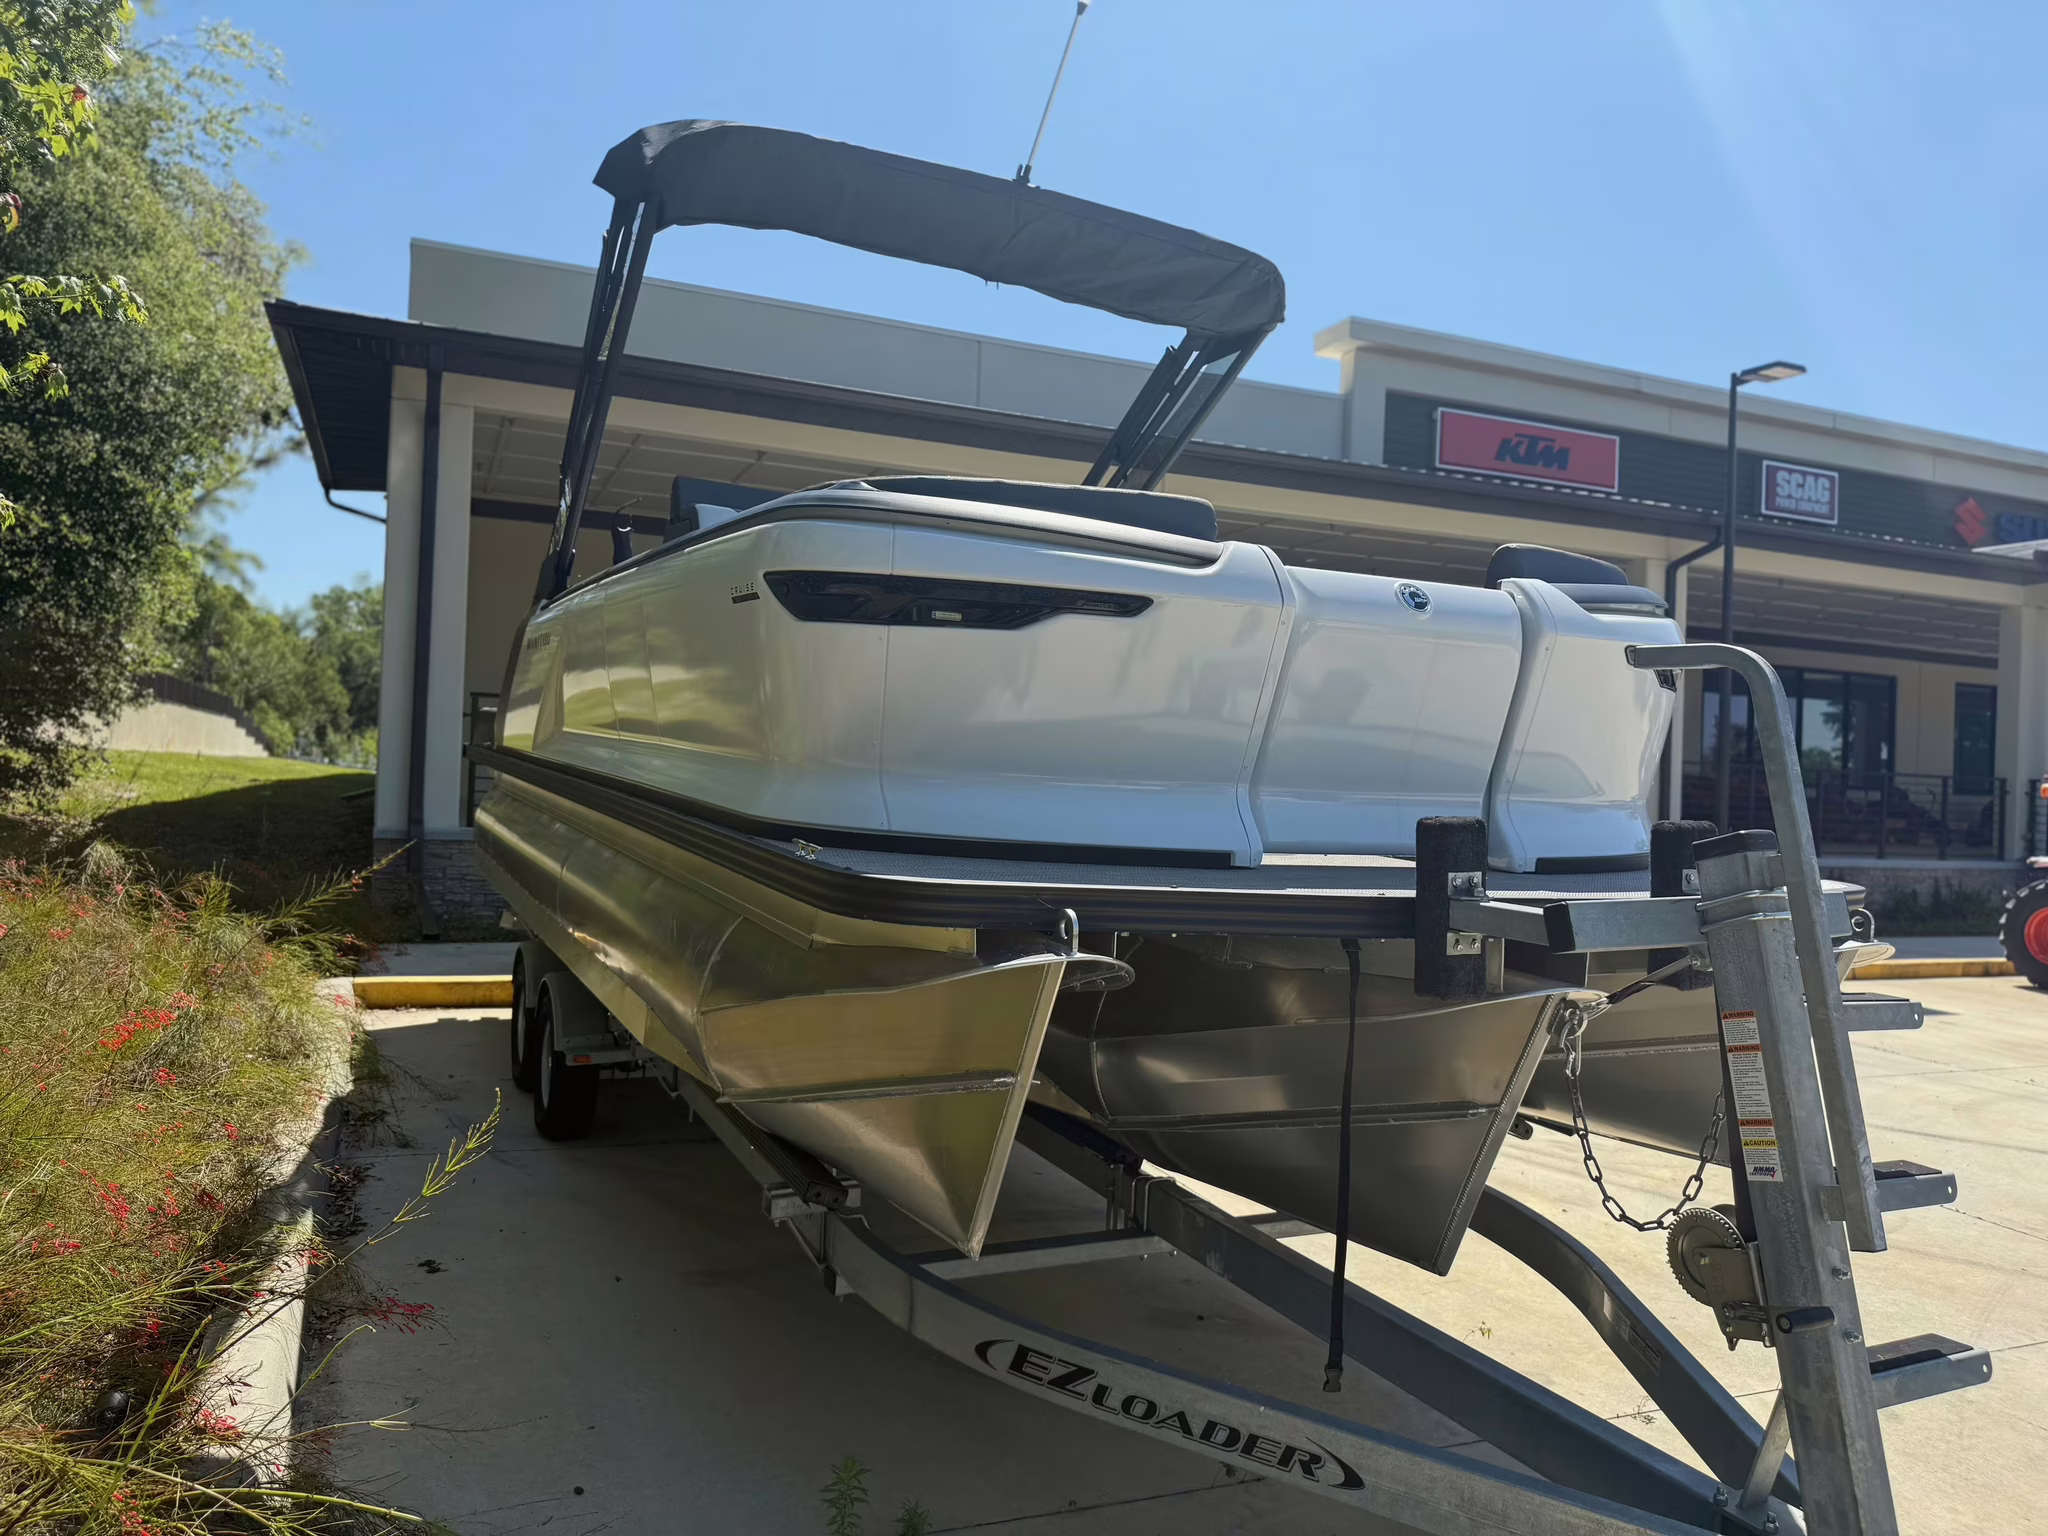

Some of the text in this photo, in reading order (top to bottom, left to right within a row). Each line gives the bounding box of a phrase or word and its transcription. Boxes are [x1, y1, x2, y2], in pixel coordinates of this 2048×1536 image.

[1494, 433, 1570, 471] KTM
[1776, 470, 1830, 503] SCAG
[1727, 1010, 1755, 1018] WARNING
[1732, 1044, 1760, 1052] WARNING
